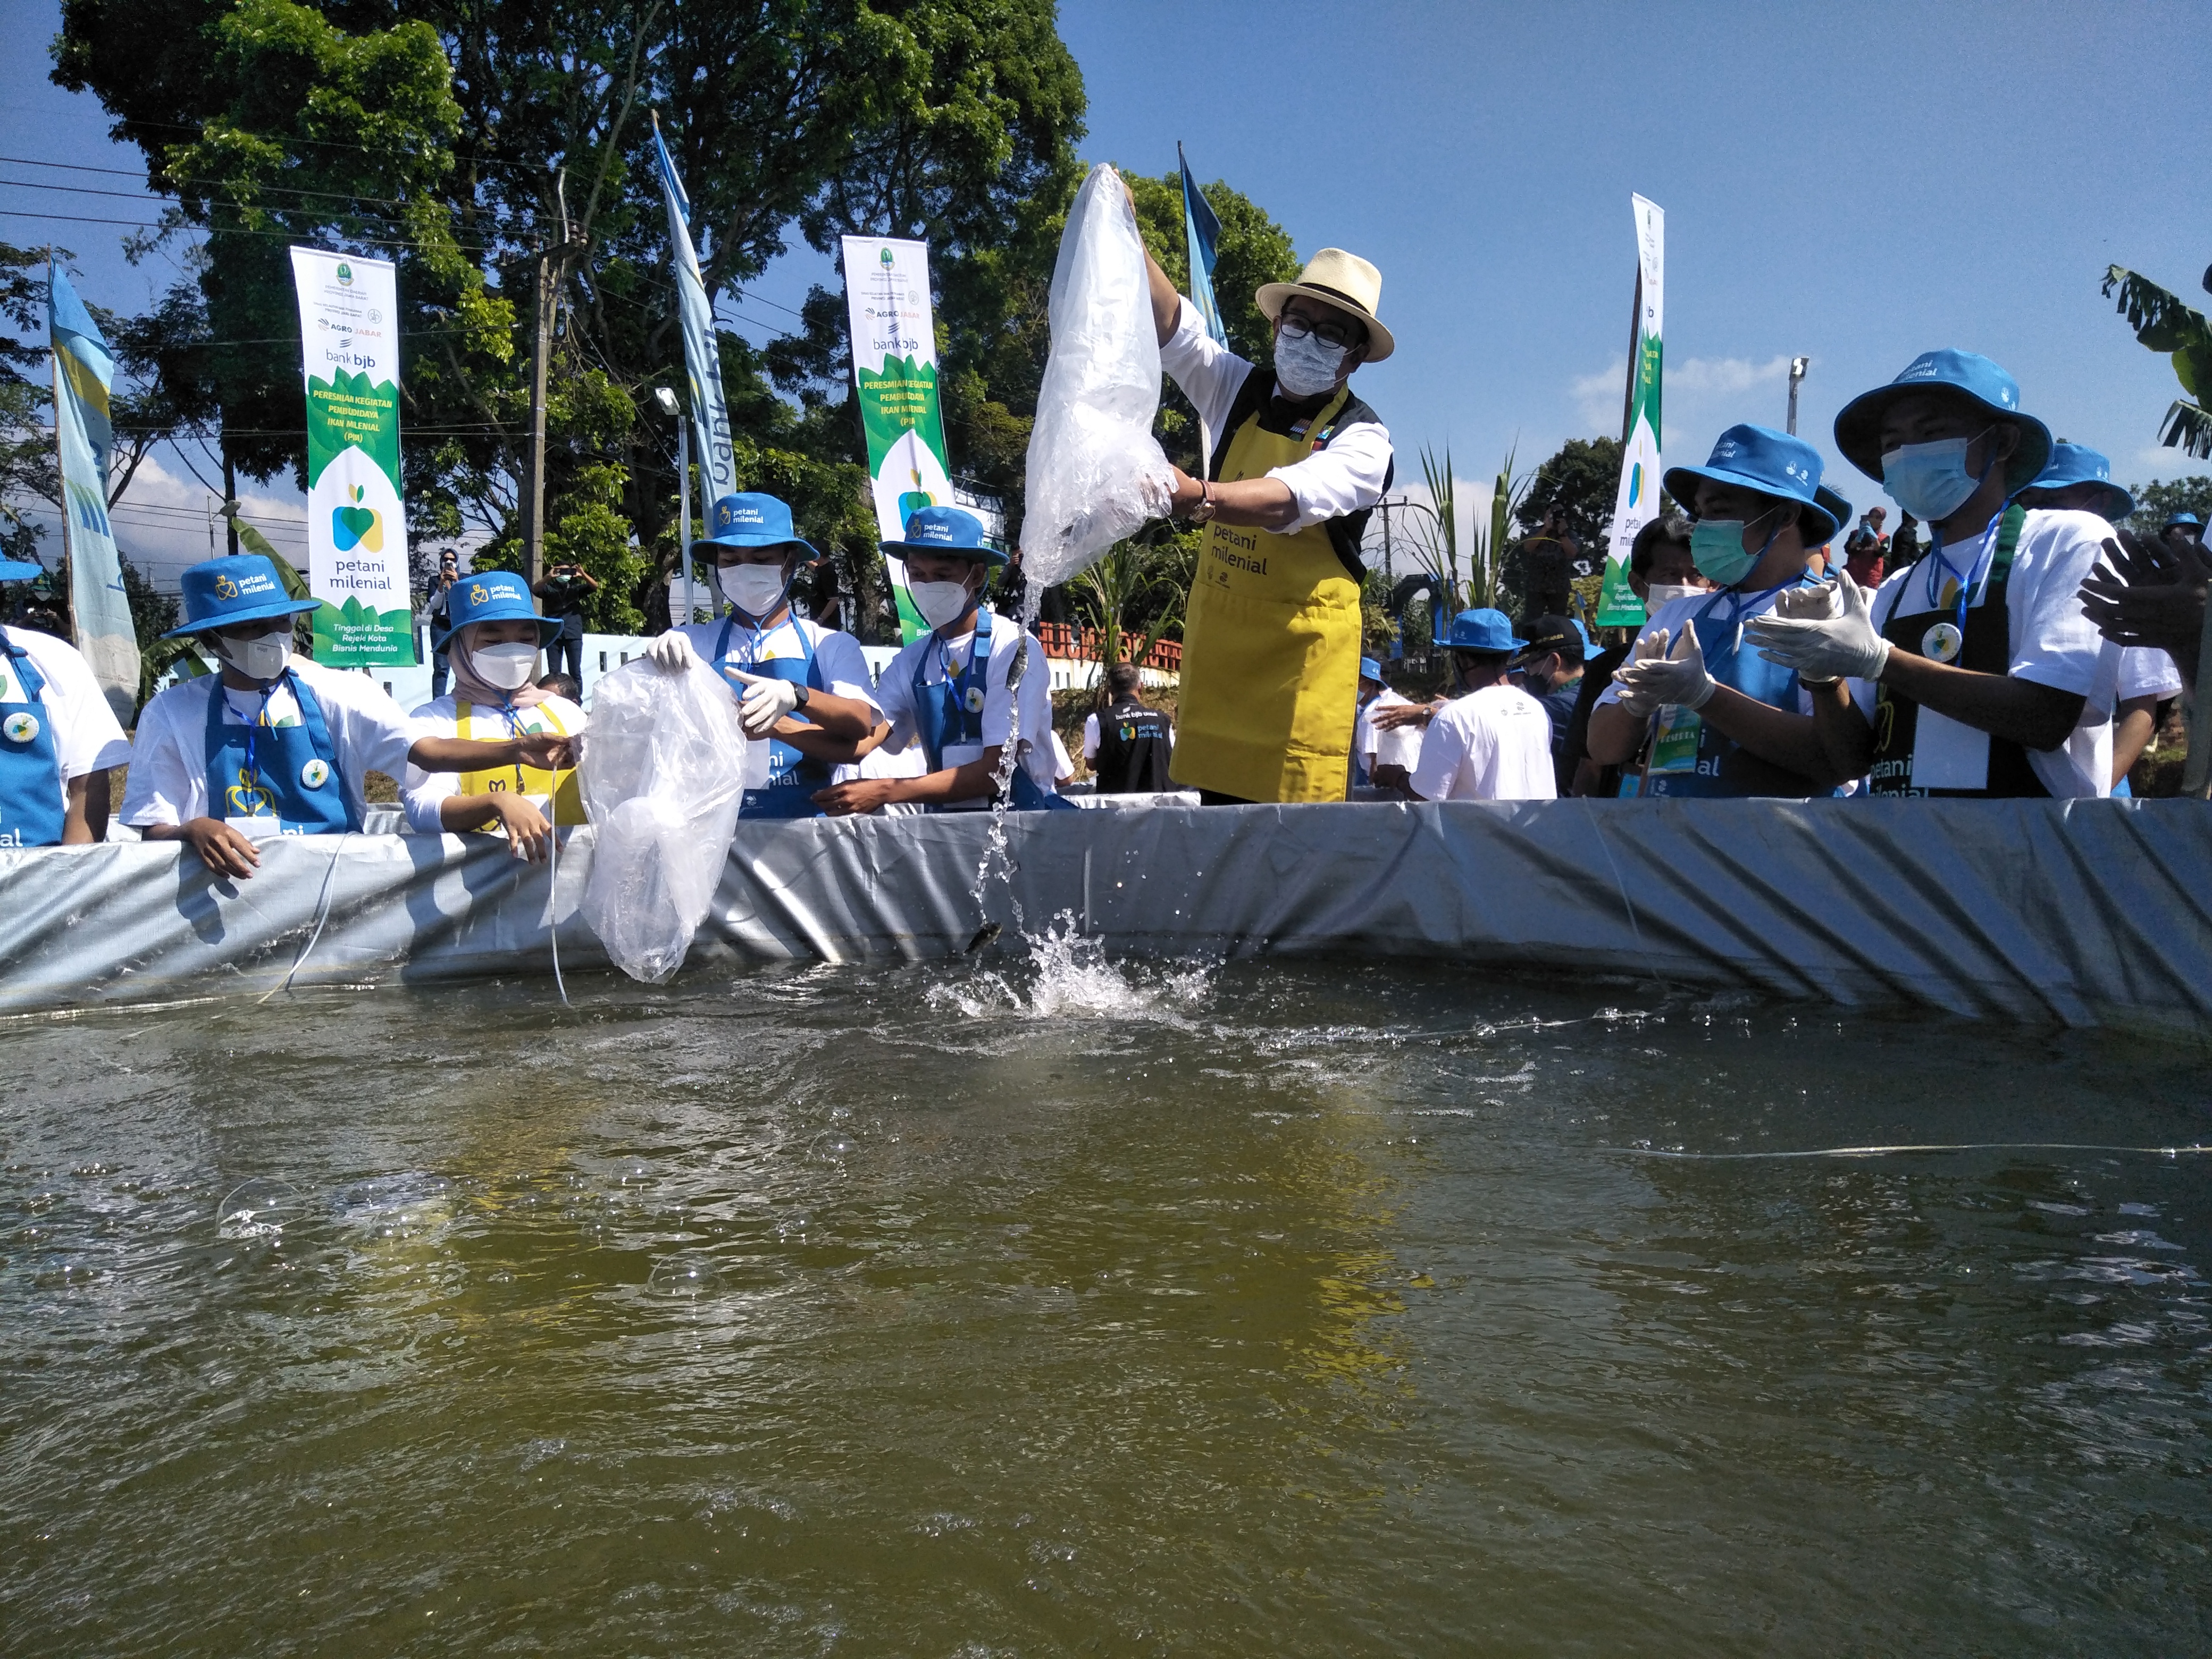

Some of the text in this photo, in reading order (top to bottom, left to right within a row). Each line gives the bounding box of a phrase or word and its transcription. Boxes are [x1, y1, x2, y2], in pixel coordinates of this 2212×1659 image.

[331, 324, 382, 338] AGRO JABAR
[873, 337, 918, 351] bank bjb
[326, 348, 375, 368] bank bjb
[864, 379, 908, 390] PERESMIAN
[313, 390, 392, 408] PERESMIAN KEGIATAN
[328, 404, 379, 419] PEMBUDIDAYA
[881, 406, 899, 415] IKAN
[328, 417, 380, 432] IKAN MILENIAL
[344, 431, 363, 443] (PIM)
[733, 508, 758, 517] petani
[923, 531, 953, 541] milenial
[1213, 524, 1257, 551] petani
[336, 559, 384, 575] petani
[1211, 546, 1267, 575] milenial
[239, 574, 267, 588] petani
[241, 581, 275, 595] milenial
[329, 575, 392, 590] milenial
[490, 584, 515, 594] petani
[333, 624, 364, 633] Tinggal
[342, 634, 366, 644] Rejeki
[359, 642, 398, 652] Mendunia
[1138, 724, 1159, 733] petani
